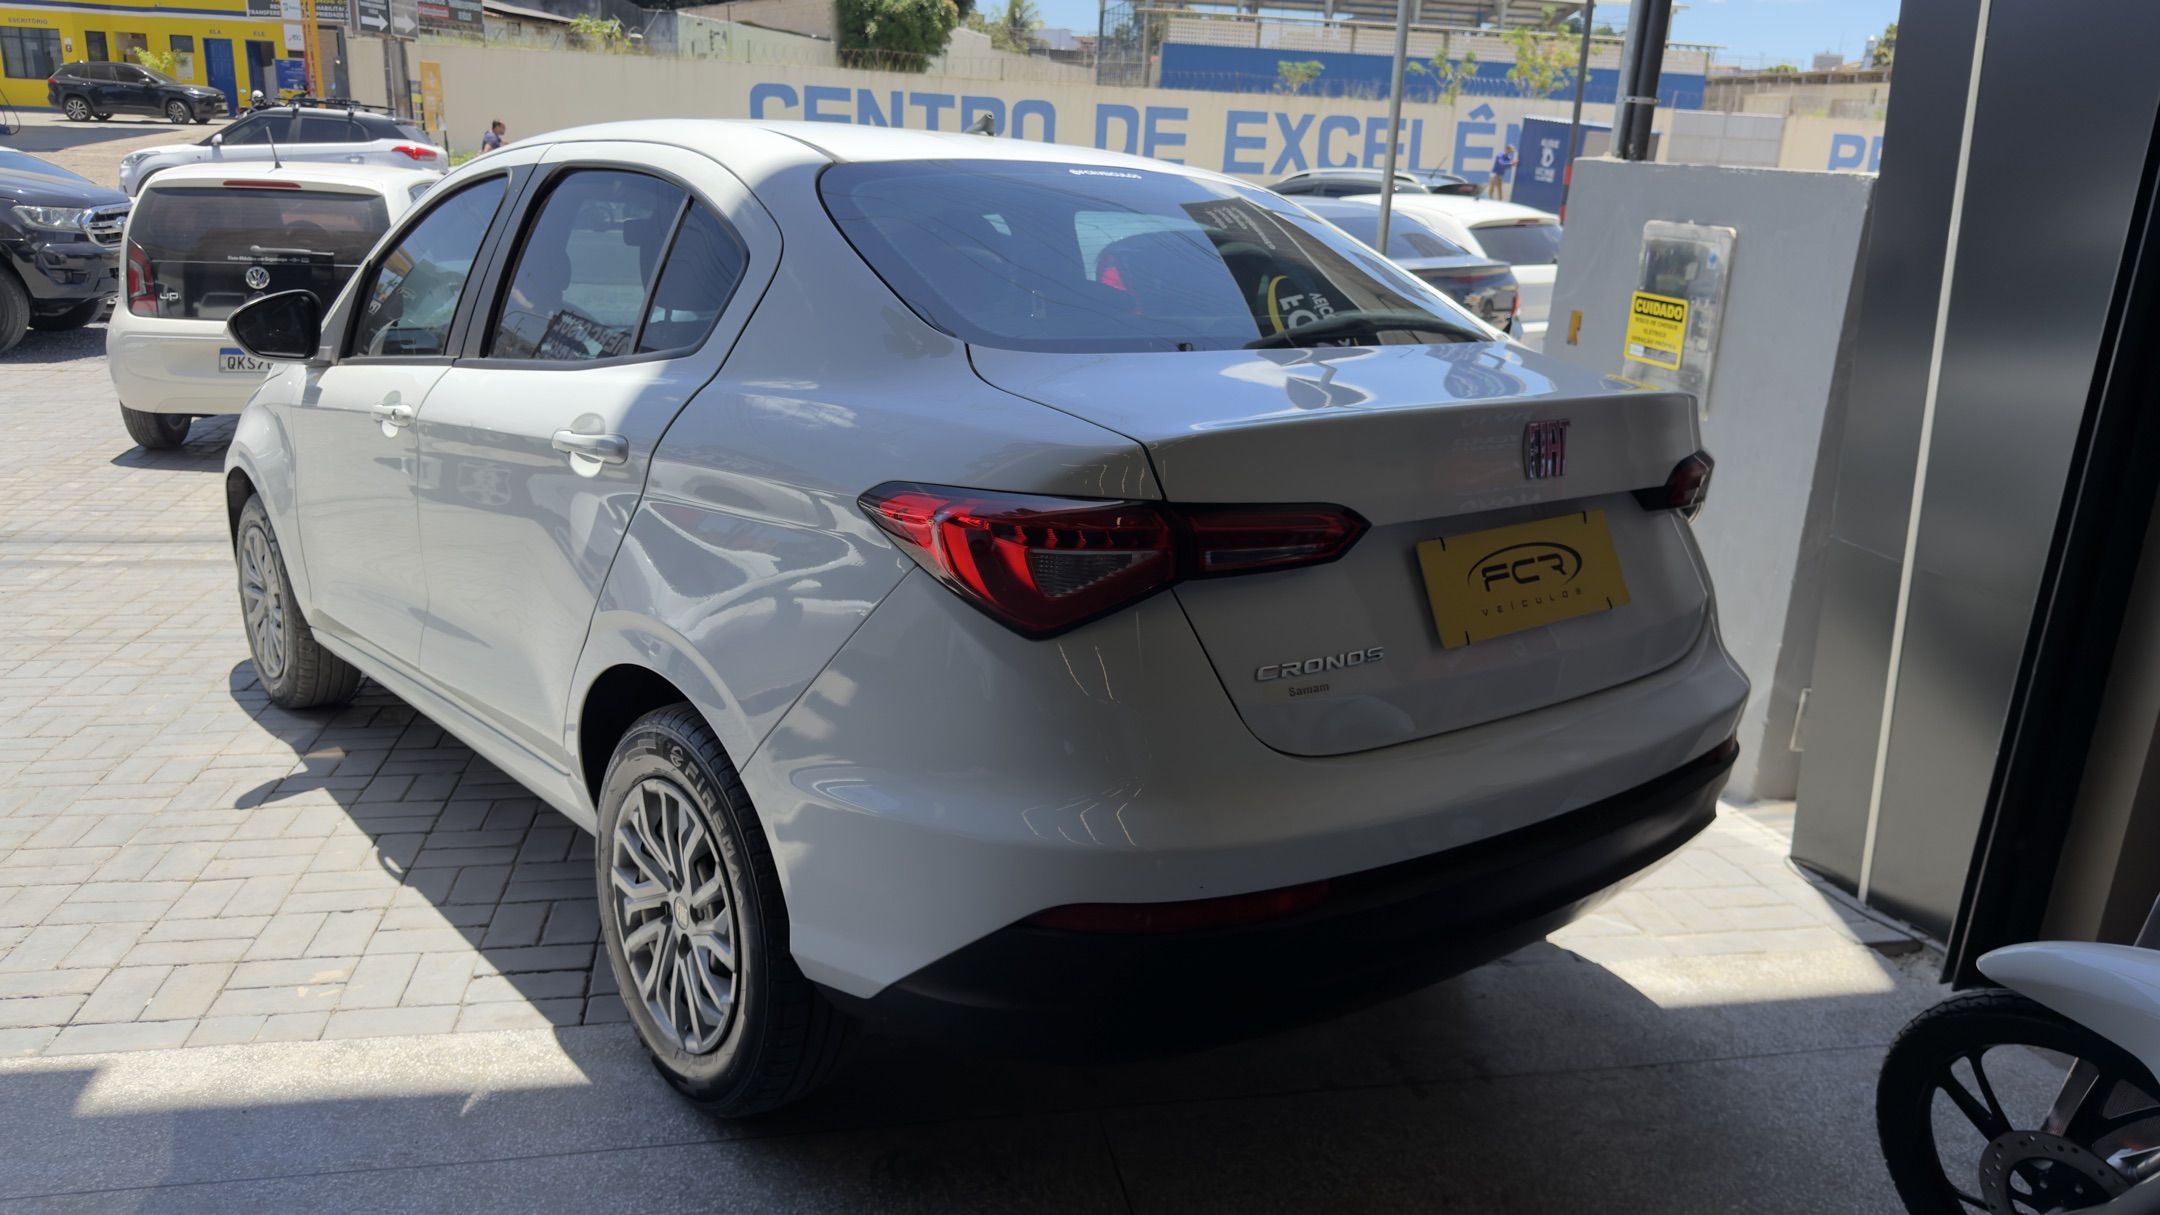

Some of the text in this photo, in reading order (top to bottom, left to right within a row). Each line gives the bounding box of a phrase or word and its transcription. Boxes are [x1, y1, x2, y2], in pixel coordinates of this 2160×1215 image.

[749, 82, 1057, 144] CENTRO
[1096, 103, 1188, 164] DE
[1634, 298, 1684, 320] CUIDADO
[1650, 319, 1657, 327] DE
[1528, 419, 1571, 480] FIAT
[1481, 553, 1568, 592] FCR
[1255, 646, 1384, 682] CRONOS
[1288, 683, 1330, 697] Samam
[684, 761, 746, 909] FIREMAX
